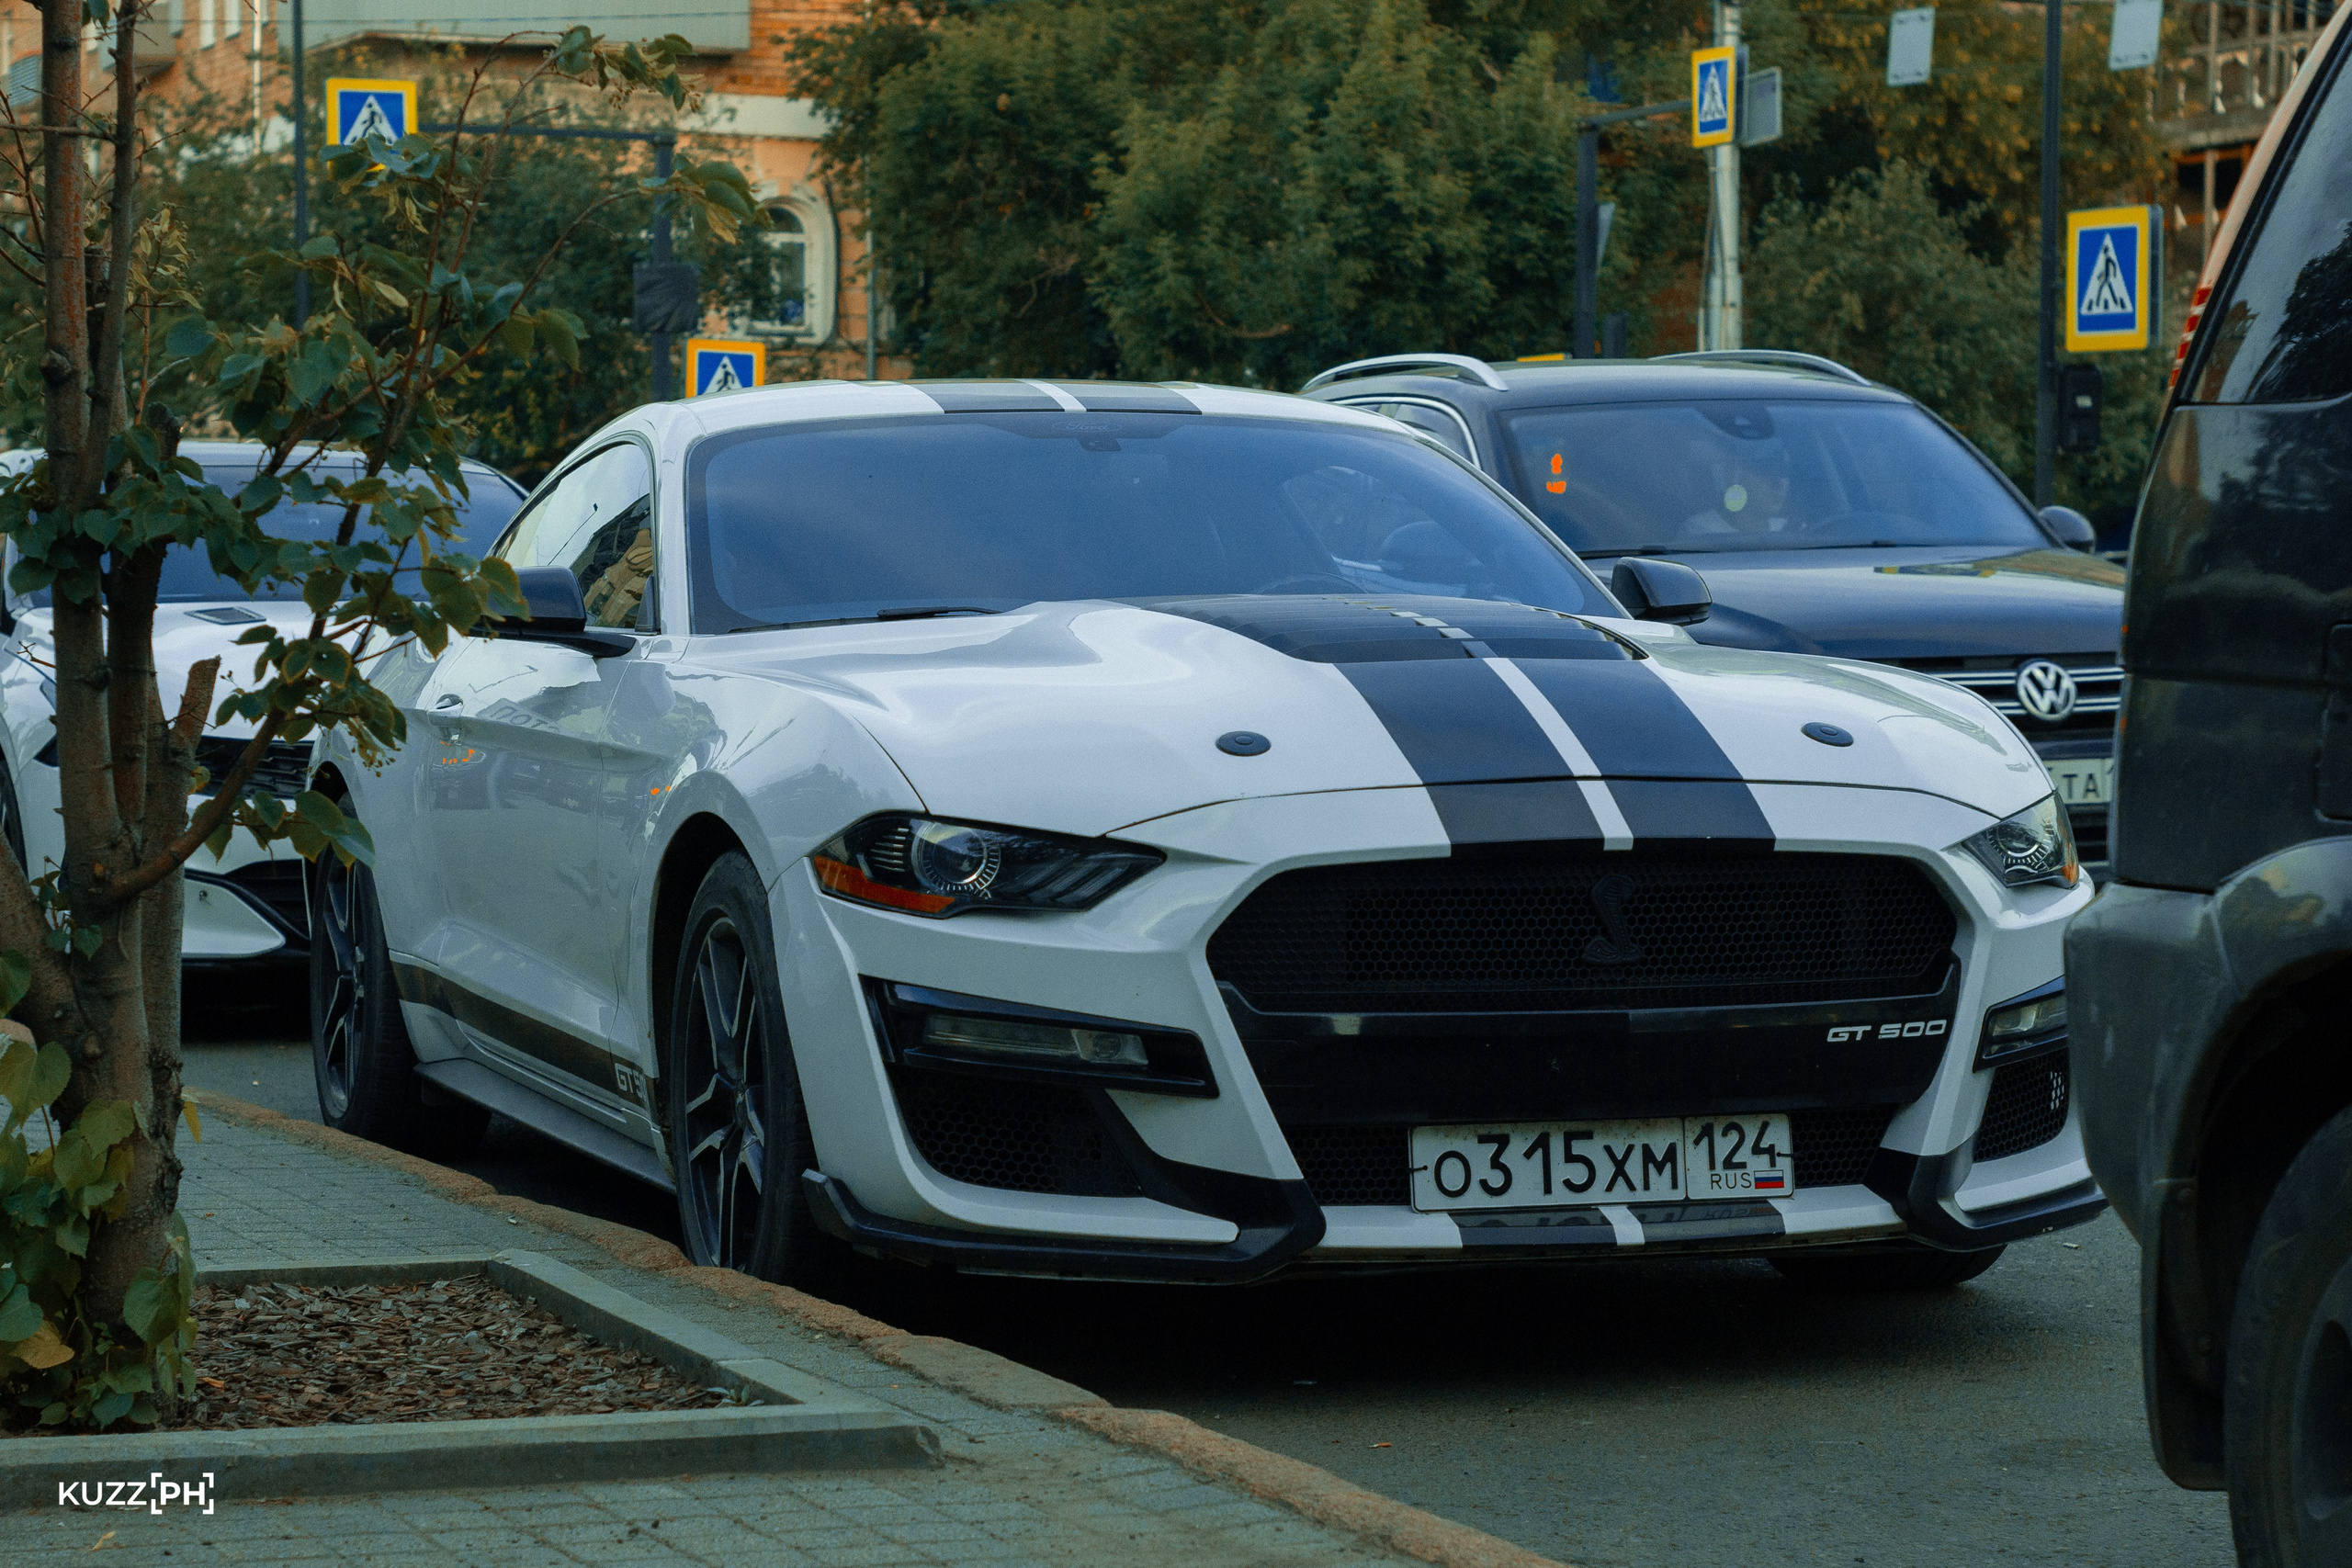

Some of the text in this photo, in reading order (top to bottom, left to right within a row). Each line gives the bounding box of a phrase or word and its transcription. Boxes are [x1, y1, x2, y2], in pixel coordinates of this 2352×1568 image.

[1826, 1020, 1948, 1043] GT 500
[1433, 1121, 1777, 1198] O315XM 124
[1711, 1172, 1752, 1190] RUS
